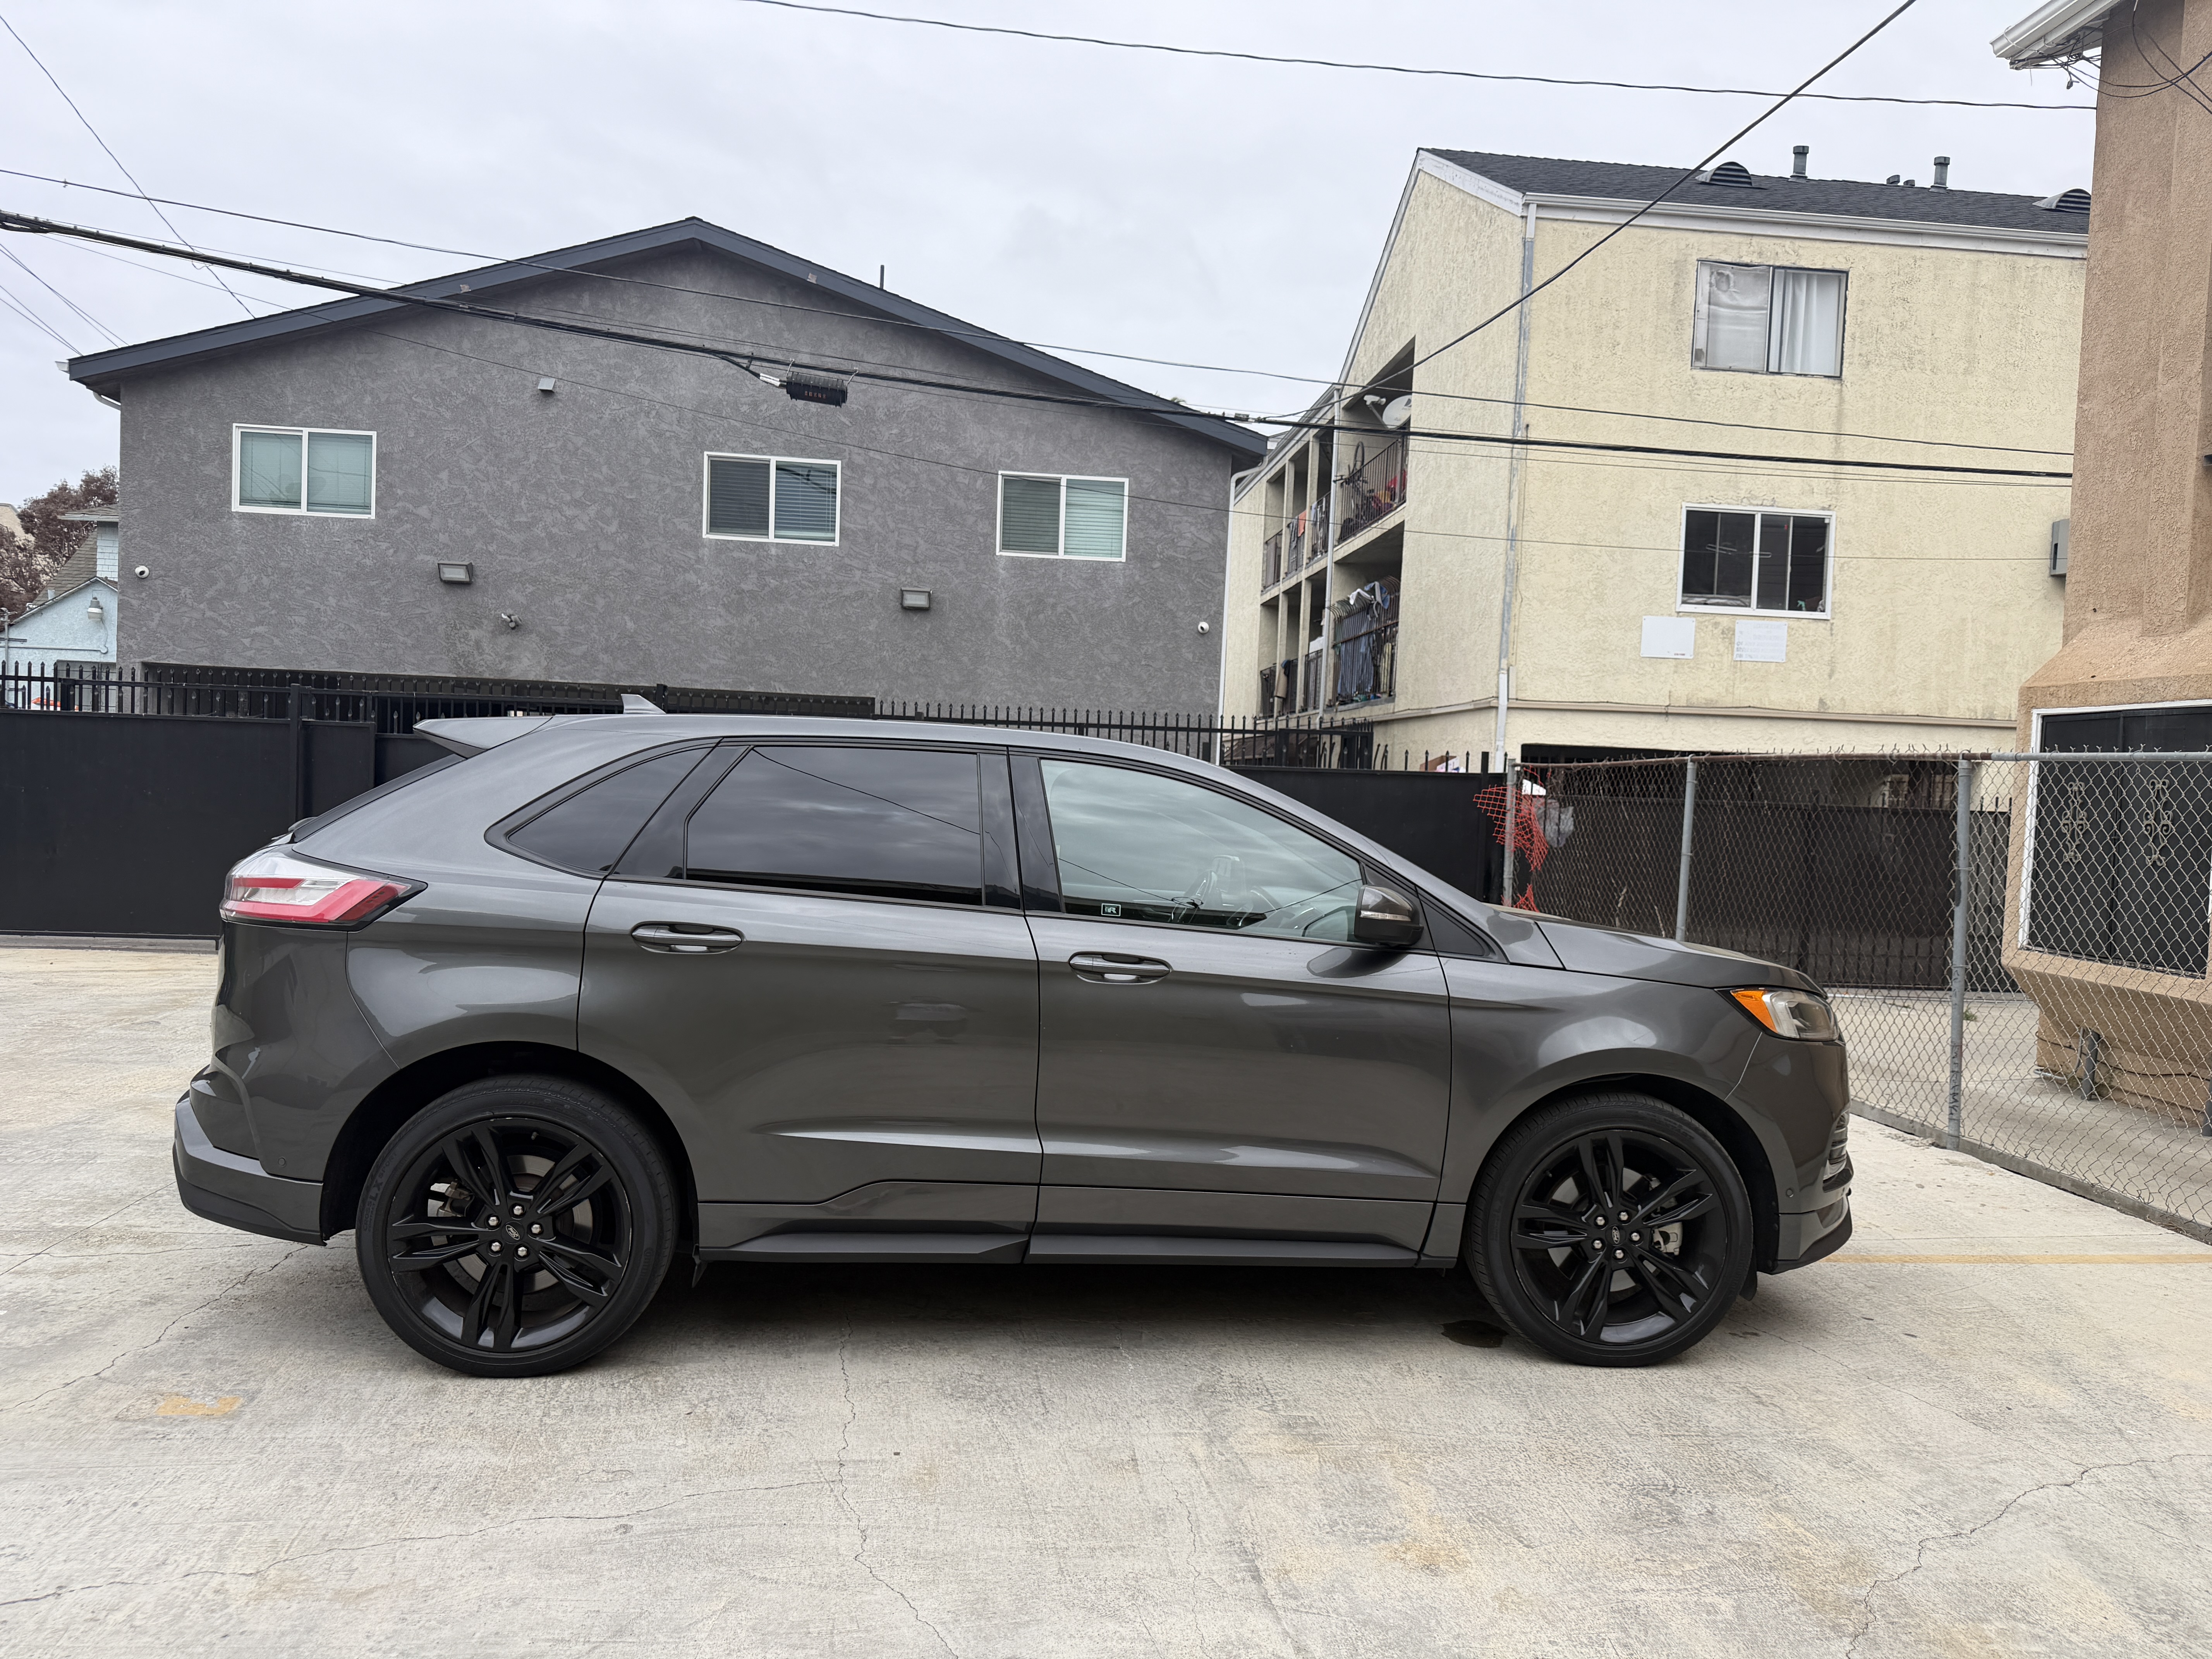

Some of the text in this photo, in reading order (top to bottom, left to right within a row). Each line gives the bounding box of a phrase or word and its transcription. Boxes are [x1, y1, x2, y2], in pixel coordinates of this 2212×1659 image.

[363, 1200, 373, 1231] CROSS
[369, 1178, 383, 1201] LX
[507, 1226, 519, 1238] Ford
